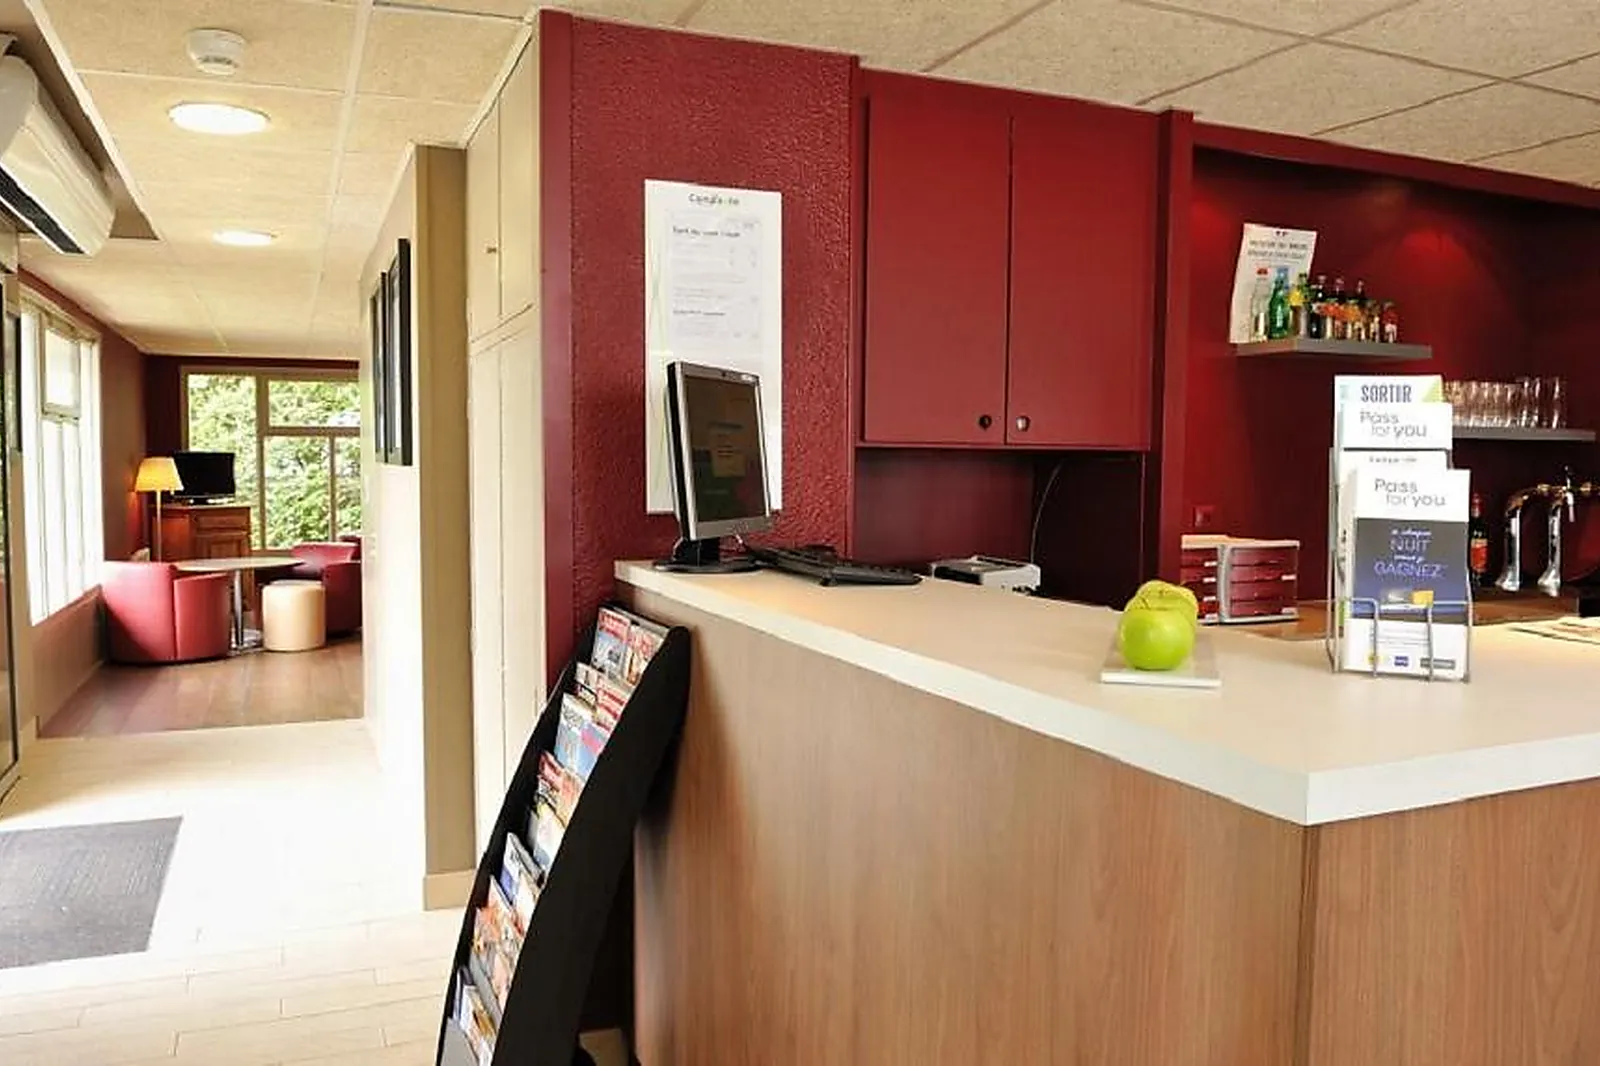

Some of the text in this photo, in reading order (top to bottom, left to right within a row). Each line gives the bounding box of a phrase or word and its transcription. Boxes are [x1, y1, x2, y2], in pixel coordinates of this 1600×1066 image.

[1360, 384, 1412, 403] SORTIR
[1360, 410, 1399, 424] Pass
[1393, 425, 1427, 439] you
[1374, 477, 1418, 493] Pass
[1386, 493, 1446, 508] for you
